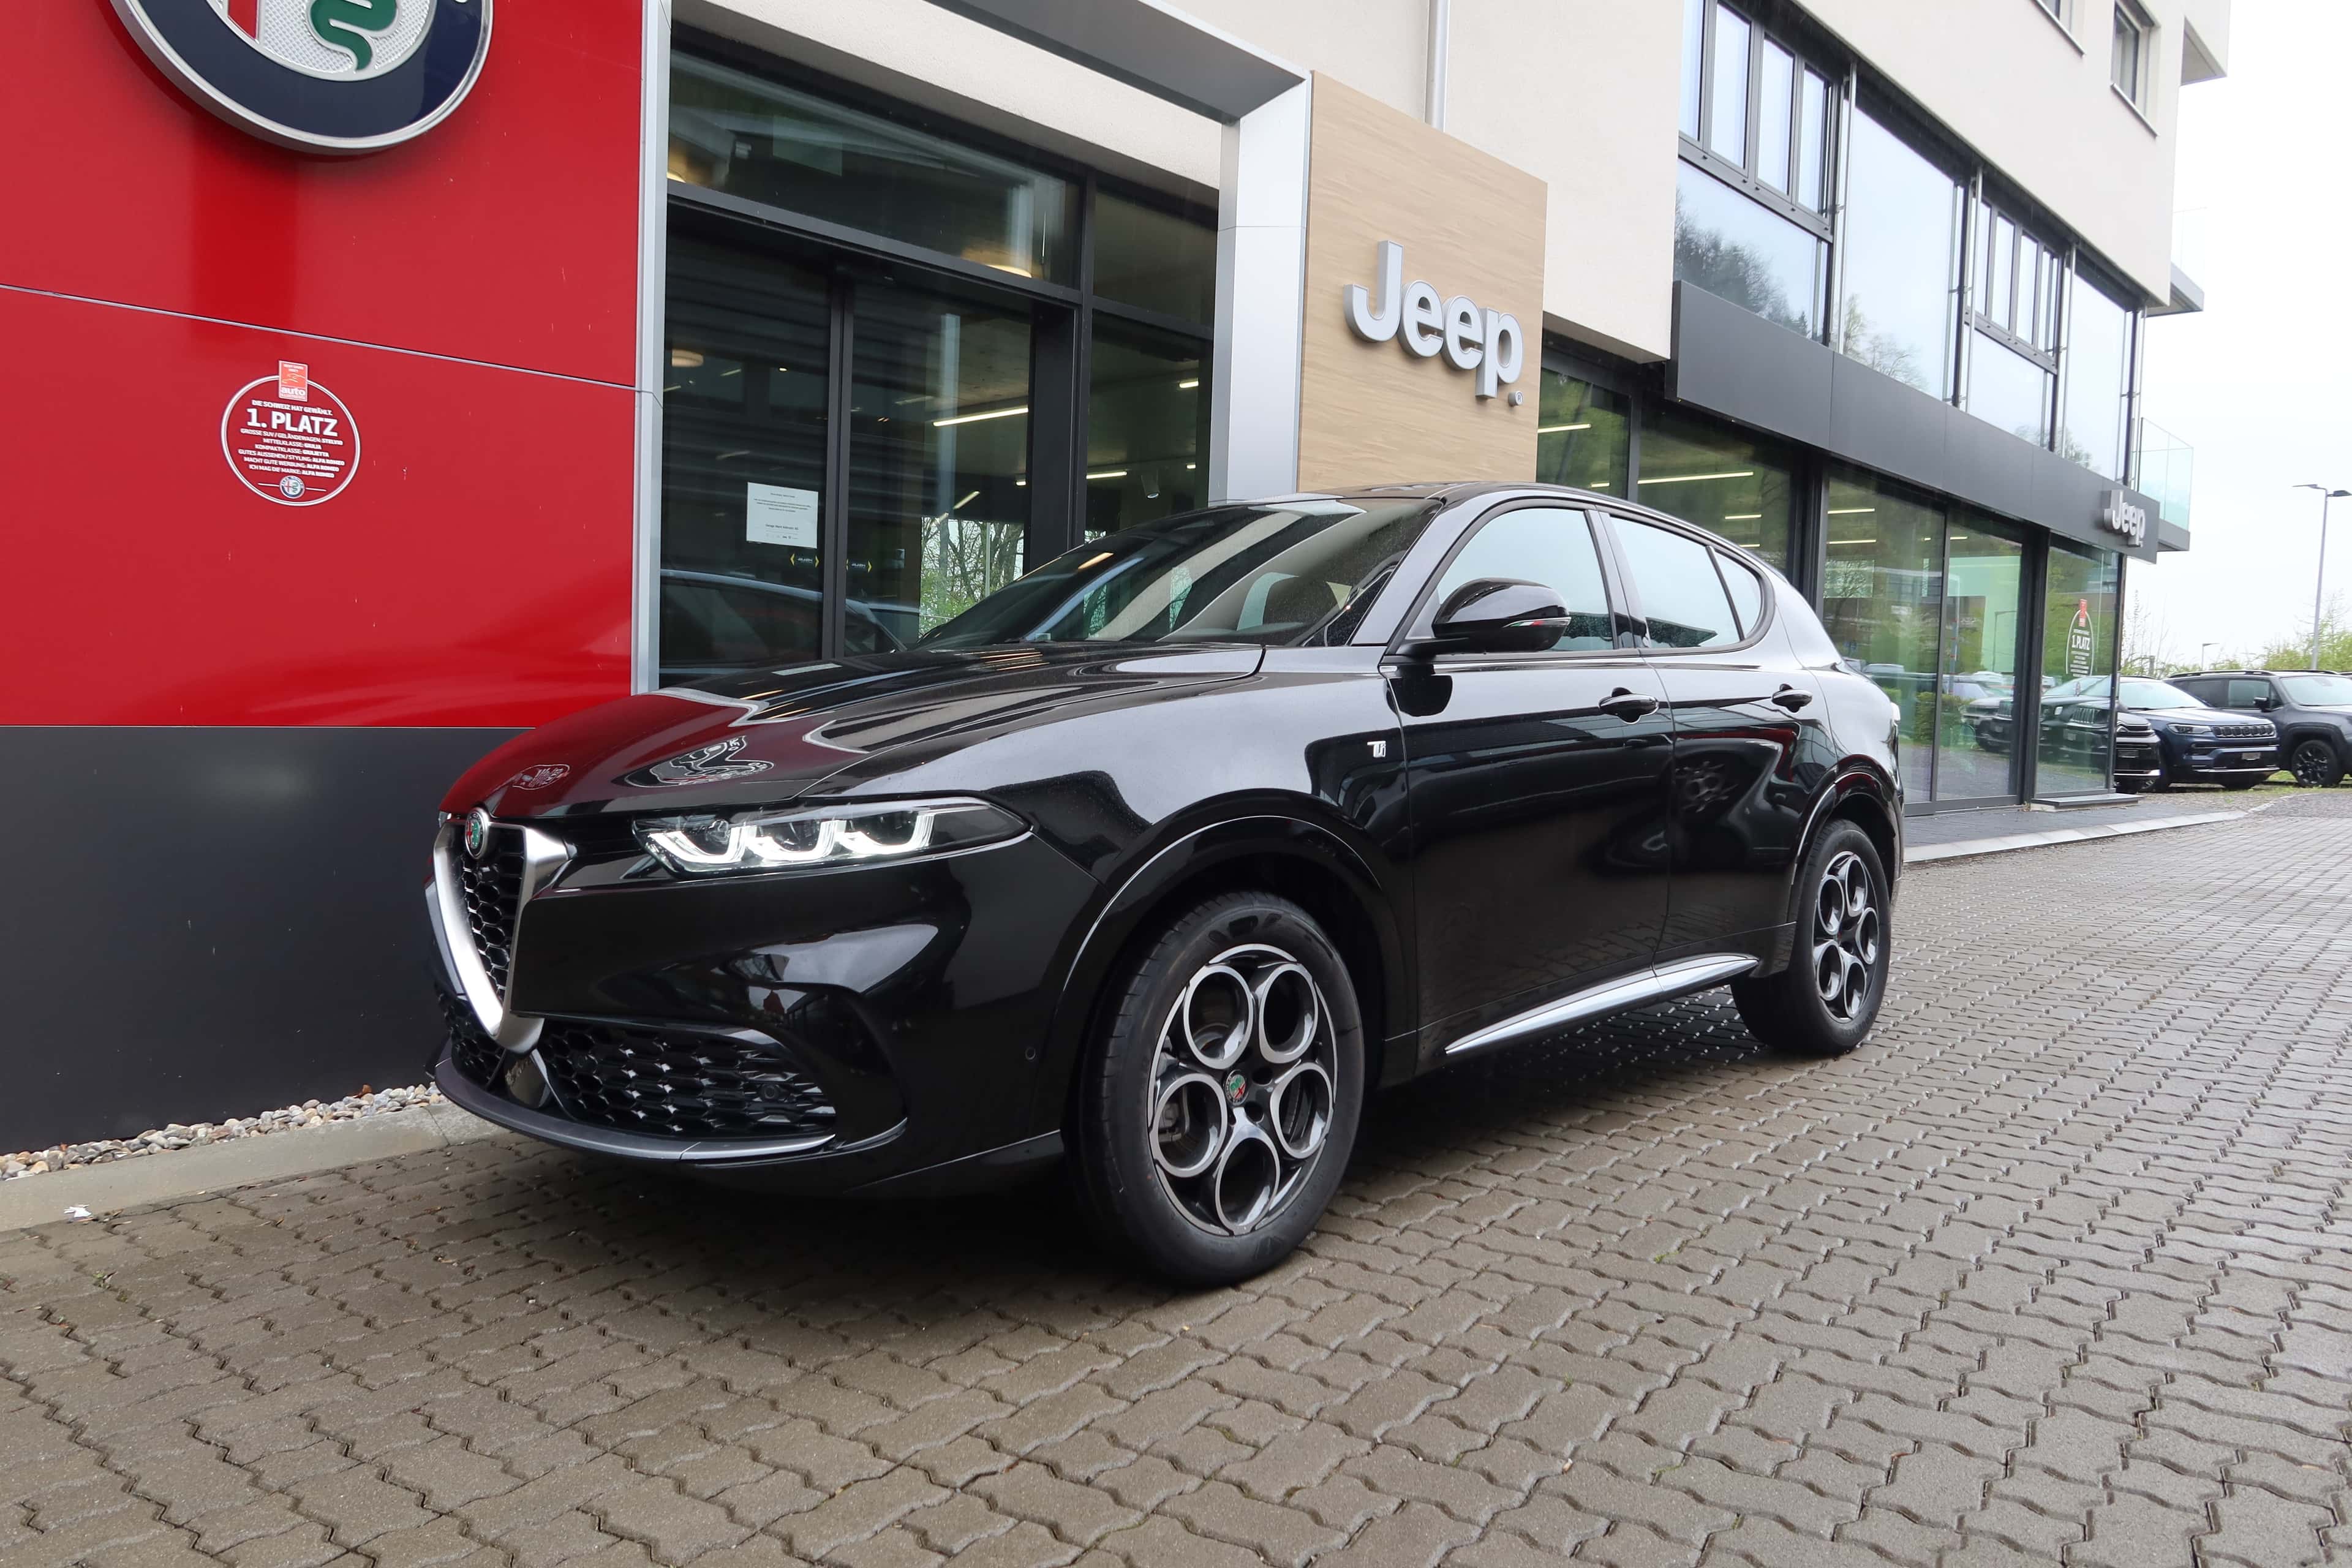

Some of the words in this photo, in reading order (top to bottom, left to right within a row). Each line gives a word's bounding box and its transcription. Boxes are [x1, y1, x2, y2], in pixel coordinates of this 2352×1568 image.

[1343, 240, 1524, 399] Jeep
[281, 387, 306, 396] auto
[247, 408, 266, 428] 1.
[271, 411, 337, 437] PLATZ
[2104, 490, 2146, 546] Jeep
[2076, 636, 2090, 650] PLATZ
